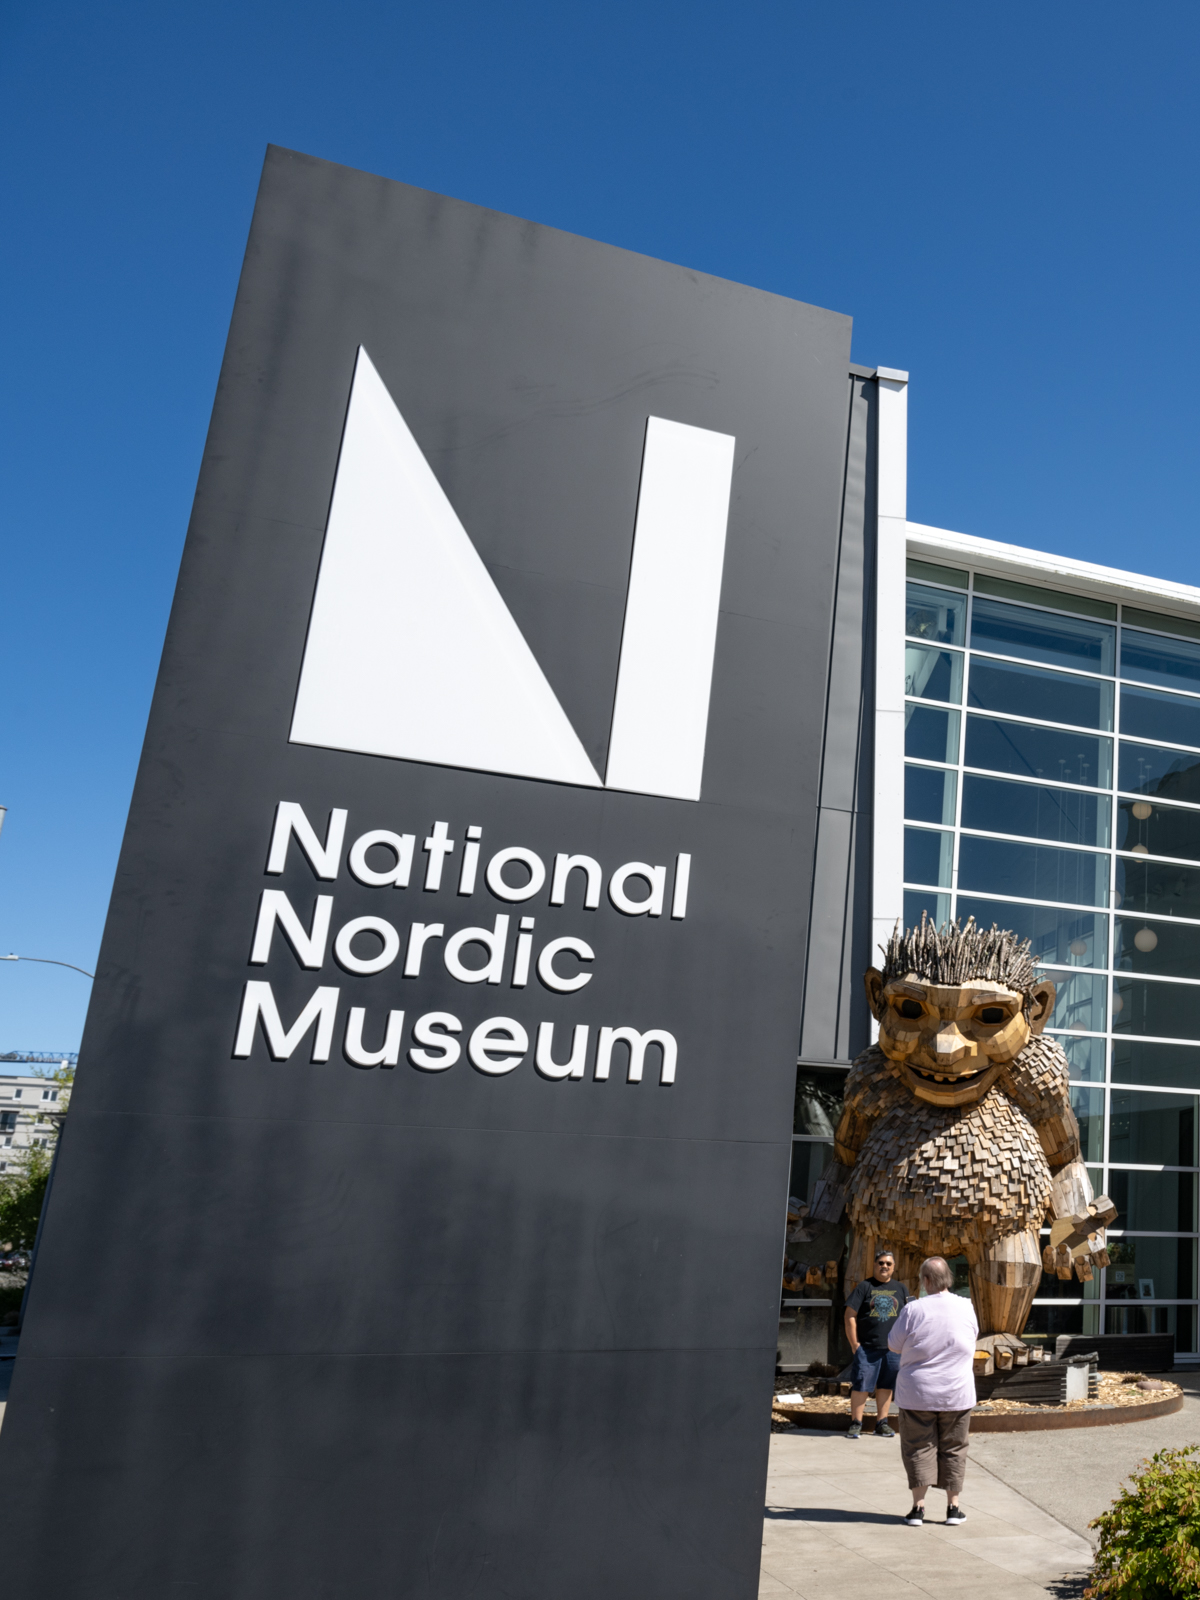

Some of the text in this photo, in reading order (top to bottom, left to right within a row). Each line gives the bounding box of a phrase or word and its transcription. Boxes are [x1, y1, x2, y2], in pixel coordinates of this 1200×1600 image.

[266, 800, 692, 919] National
[250, 888, 596, 992] Nordic
[233, 979, 679, 1084] Museum
